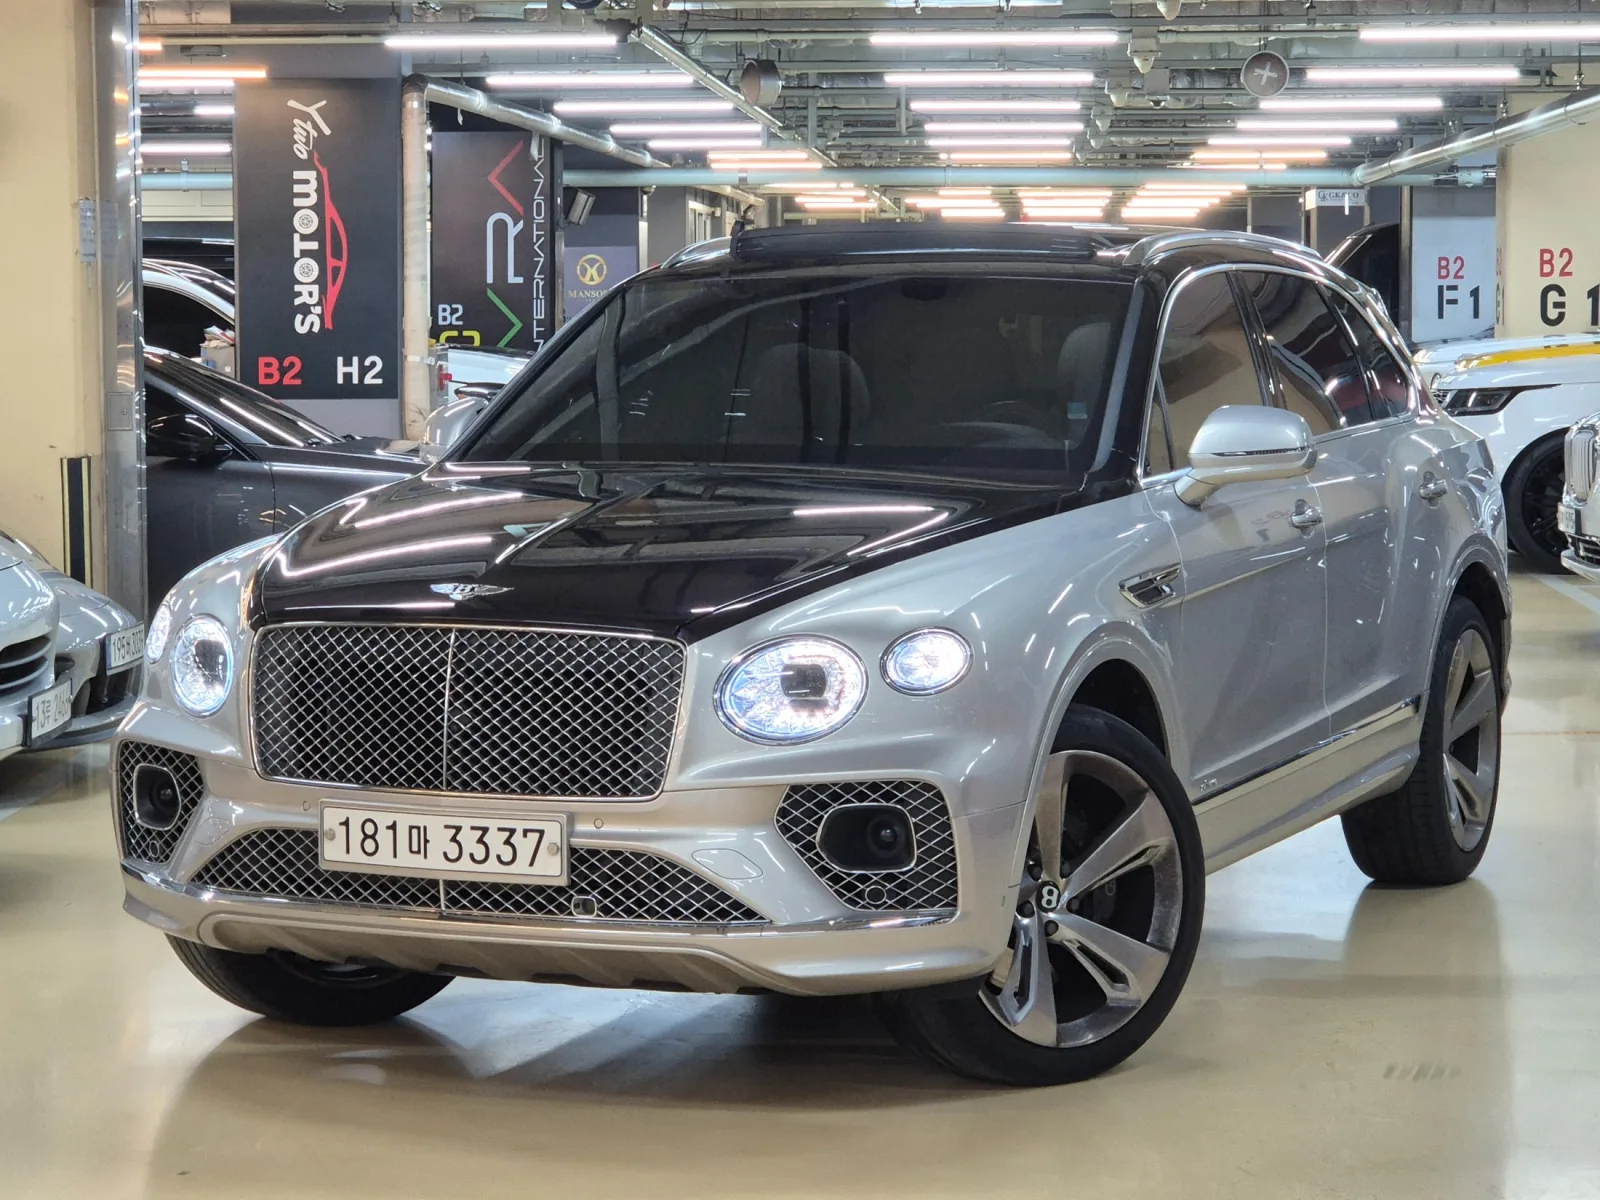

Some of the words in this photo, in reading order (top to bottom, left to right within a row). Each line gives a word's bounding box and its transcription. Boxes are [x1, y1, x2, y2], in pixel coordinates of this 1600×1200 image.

[287, 100, 332, 160] Ytwo
[1437, 255, 1465, 280] B2
[1540, 247, 1573, 278] B2
[438, 304, 464, 326] B2
[258, 356, 303, 385] B2
[336, 355, 383, 385] H2
[338, 816, 431, 860] 181마
[442, 824, 546, 868] 3337
